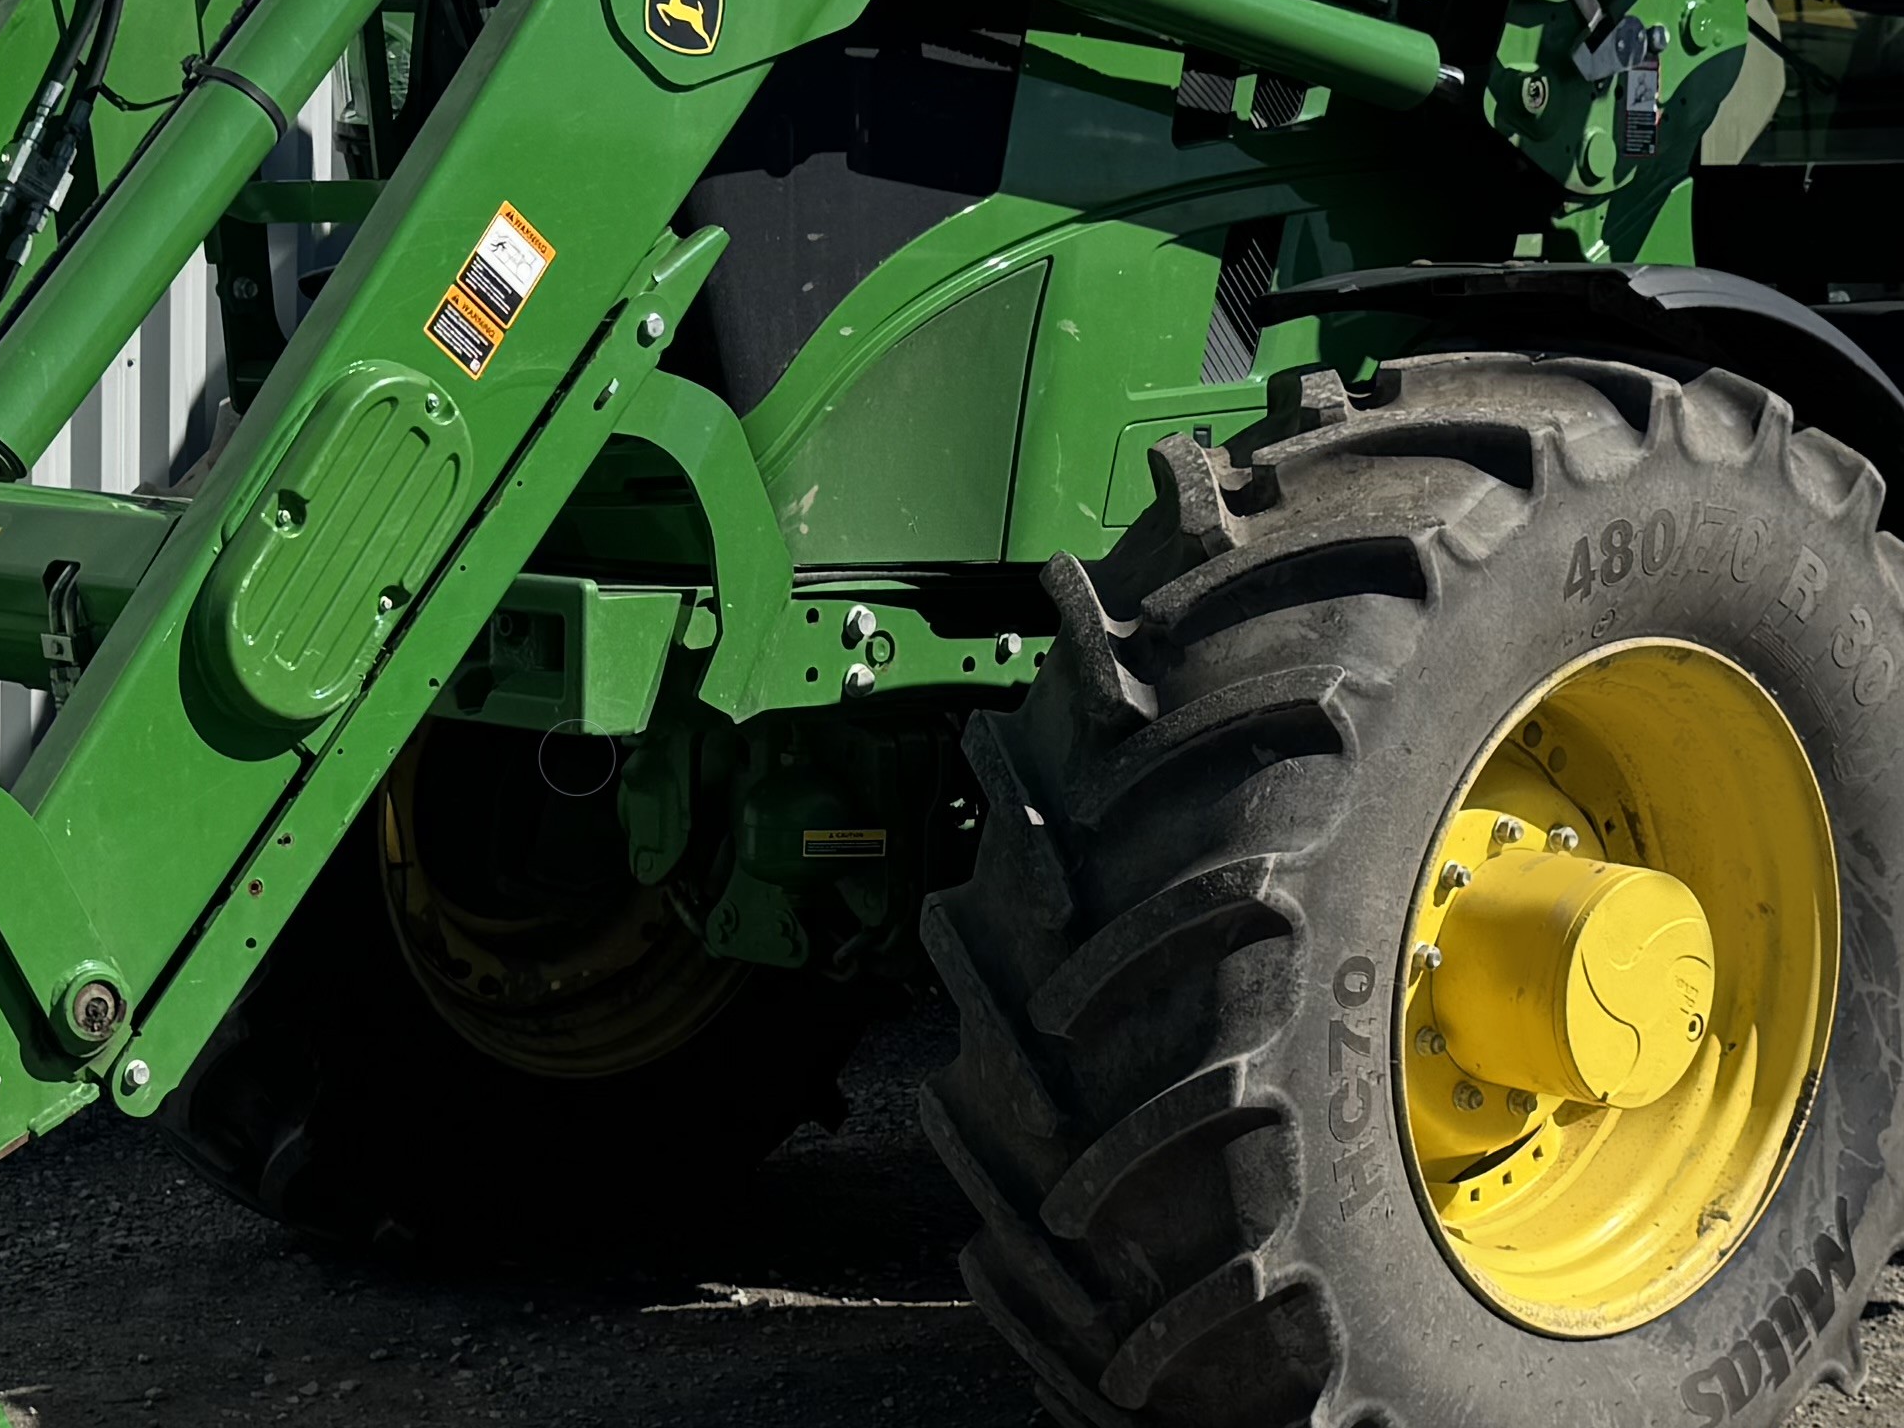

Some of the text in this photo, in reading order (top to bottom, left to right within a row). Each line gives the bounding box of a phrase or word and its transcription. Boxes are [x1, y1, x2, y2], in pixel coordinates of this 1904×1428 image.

[1563, 500, 1898, 706] 480/70 R 30
[1328, 954, 1379, 1225] HC70
